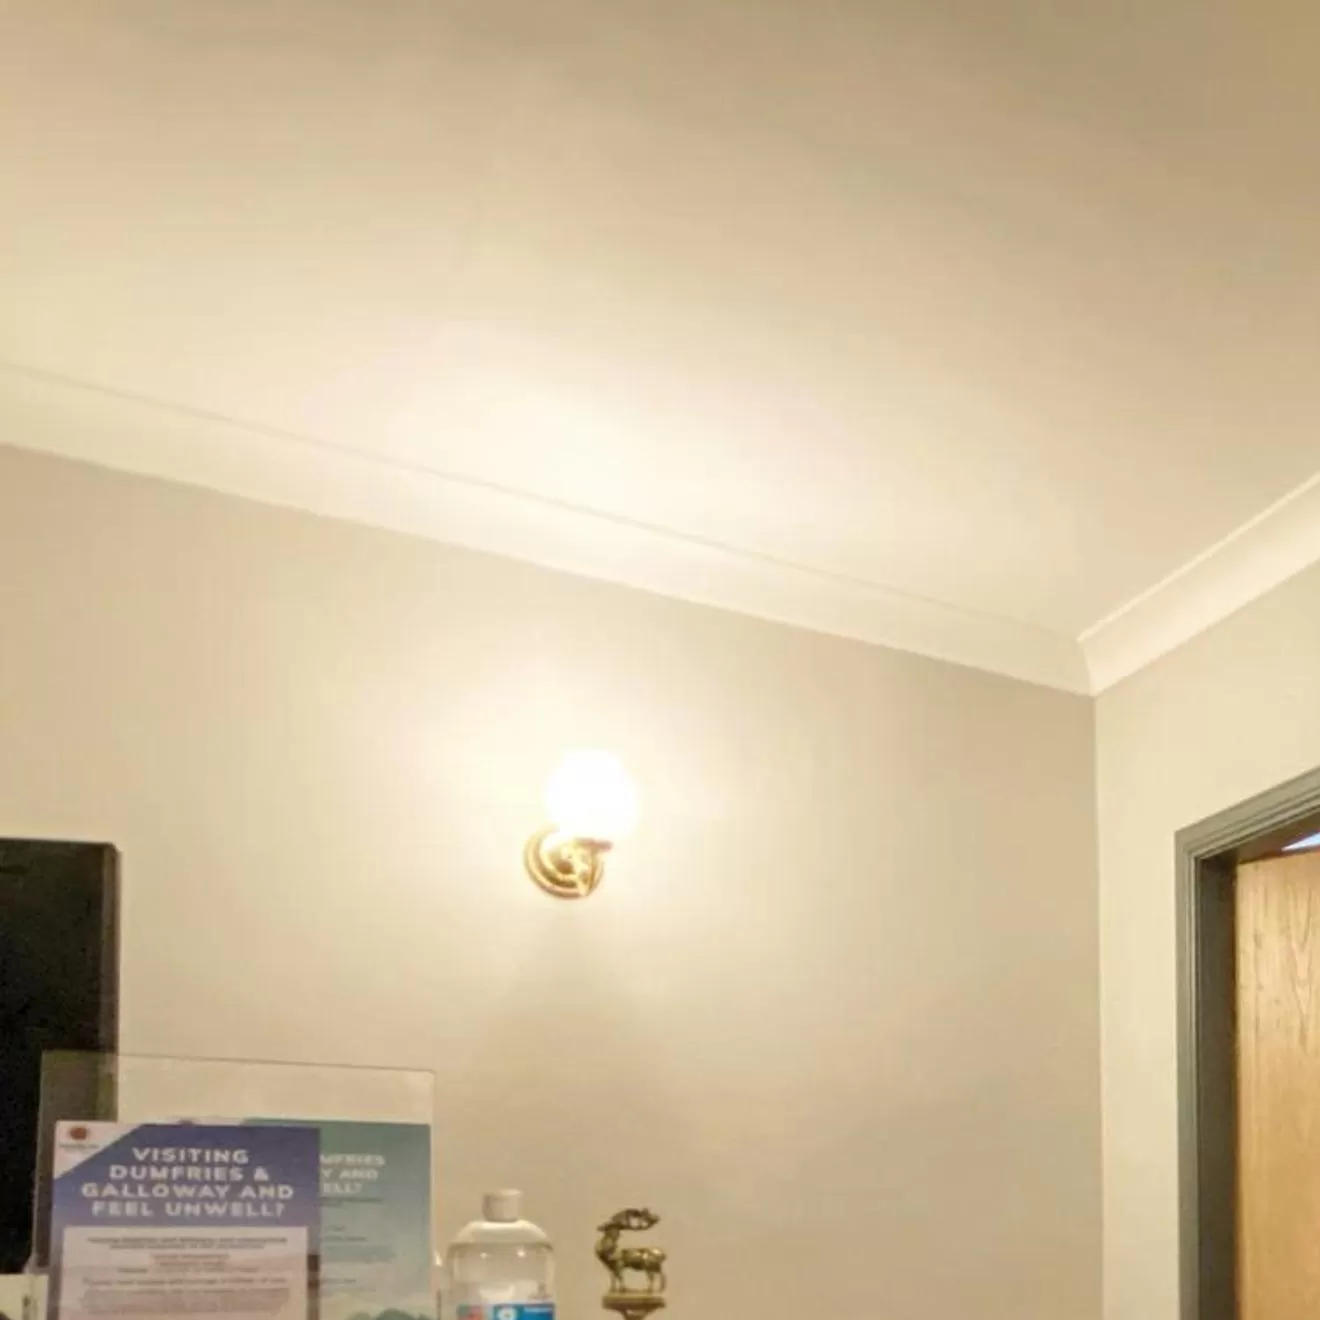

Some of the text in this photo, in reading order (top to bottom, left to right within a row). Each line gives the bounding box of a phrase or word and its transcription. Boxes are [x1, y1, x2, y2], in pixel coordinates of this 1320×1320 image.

[132, 1147, 249, 1164] VISITING
[109, 1164, 270, 1182] DUMFRIES &
[80, 1182, 294, 1200] GALLOWAY AND
[91, 1201, 286, 1218] FEEL UNWELL?
